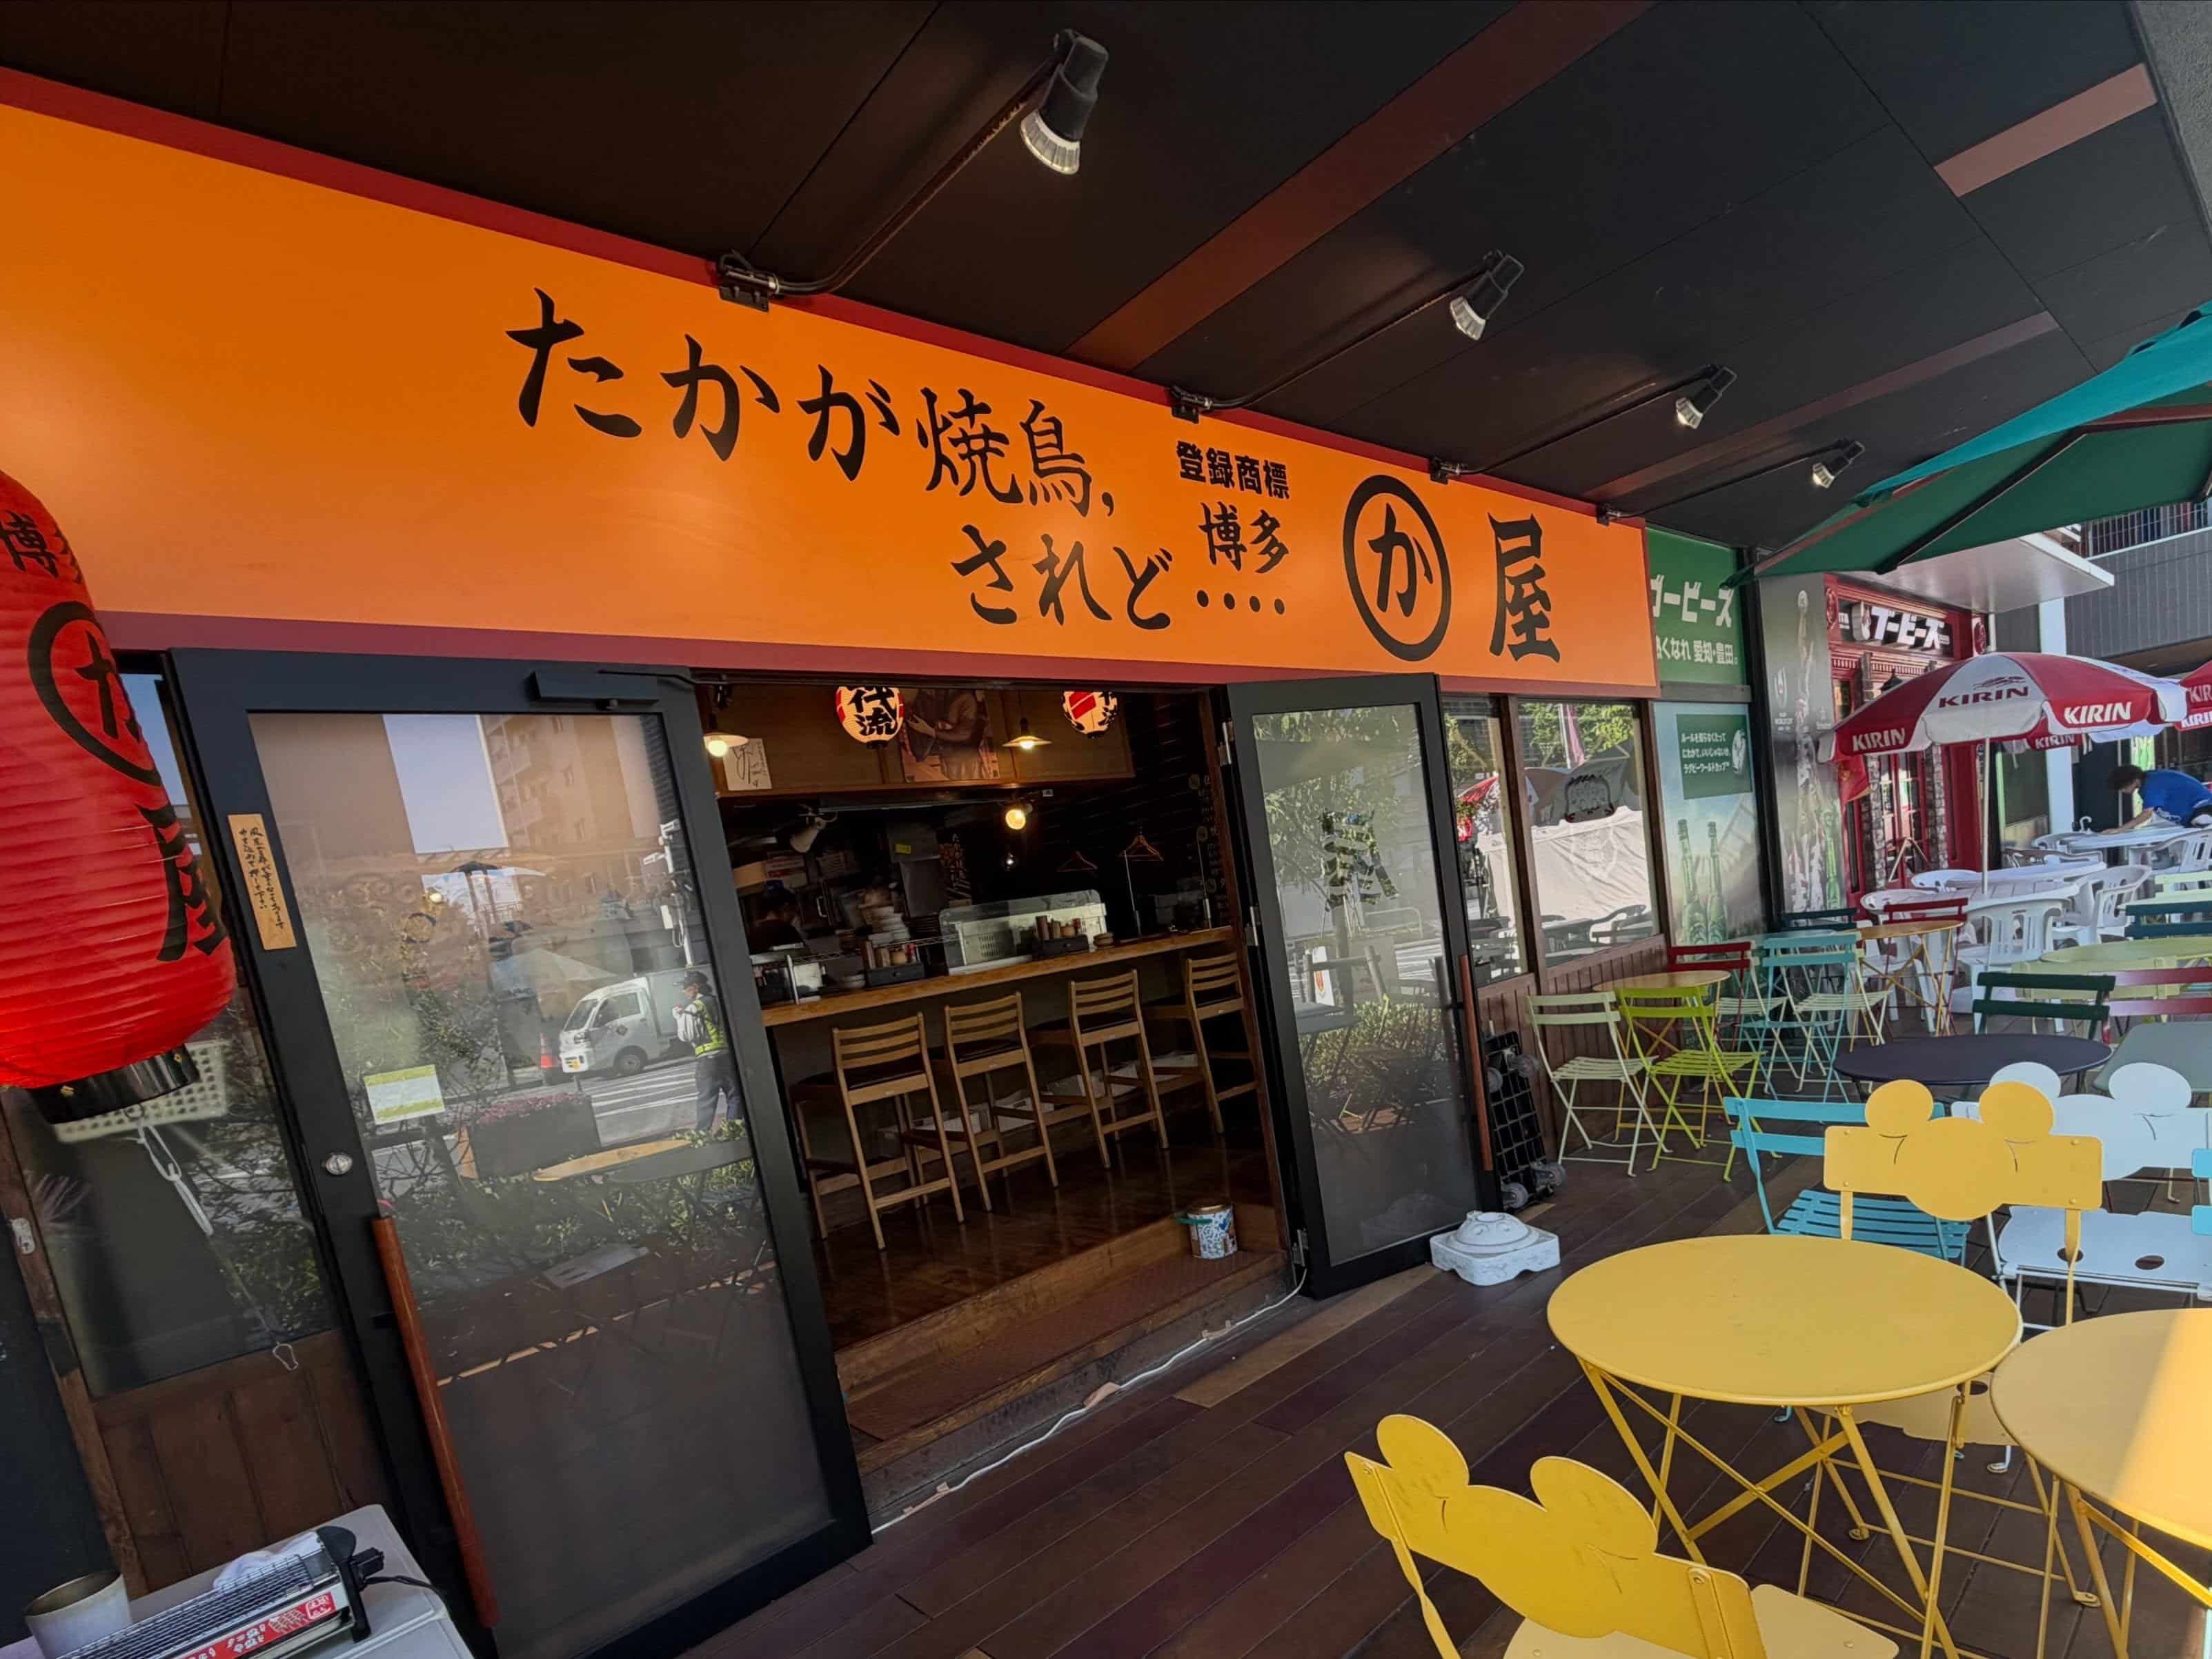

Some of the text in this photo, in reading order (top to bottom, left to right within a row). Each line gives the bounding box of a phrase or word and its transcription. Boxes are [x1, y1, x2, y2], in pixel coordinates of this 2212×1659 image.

[1176, 441, 1290, 500] 登録商標
[1198, 501, 1290, 574] 博多
[1488, 512, 1561, 664] 屋
[1939, 686, 2029, 708] KIRIN
[2064, 702, 2132, 724] KIRIN
[1853, 728, 1906, 752] KIRIN
[2035, 734, 2075, 750] KIRIN
